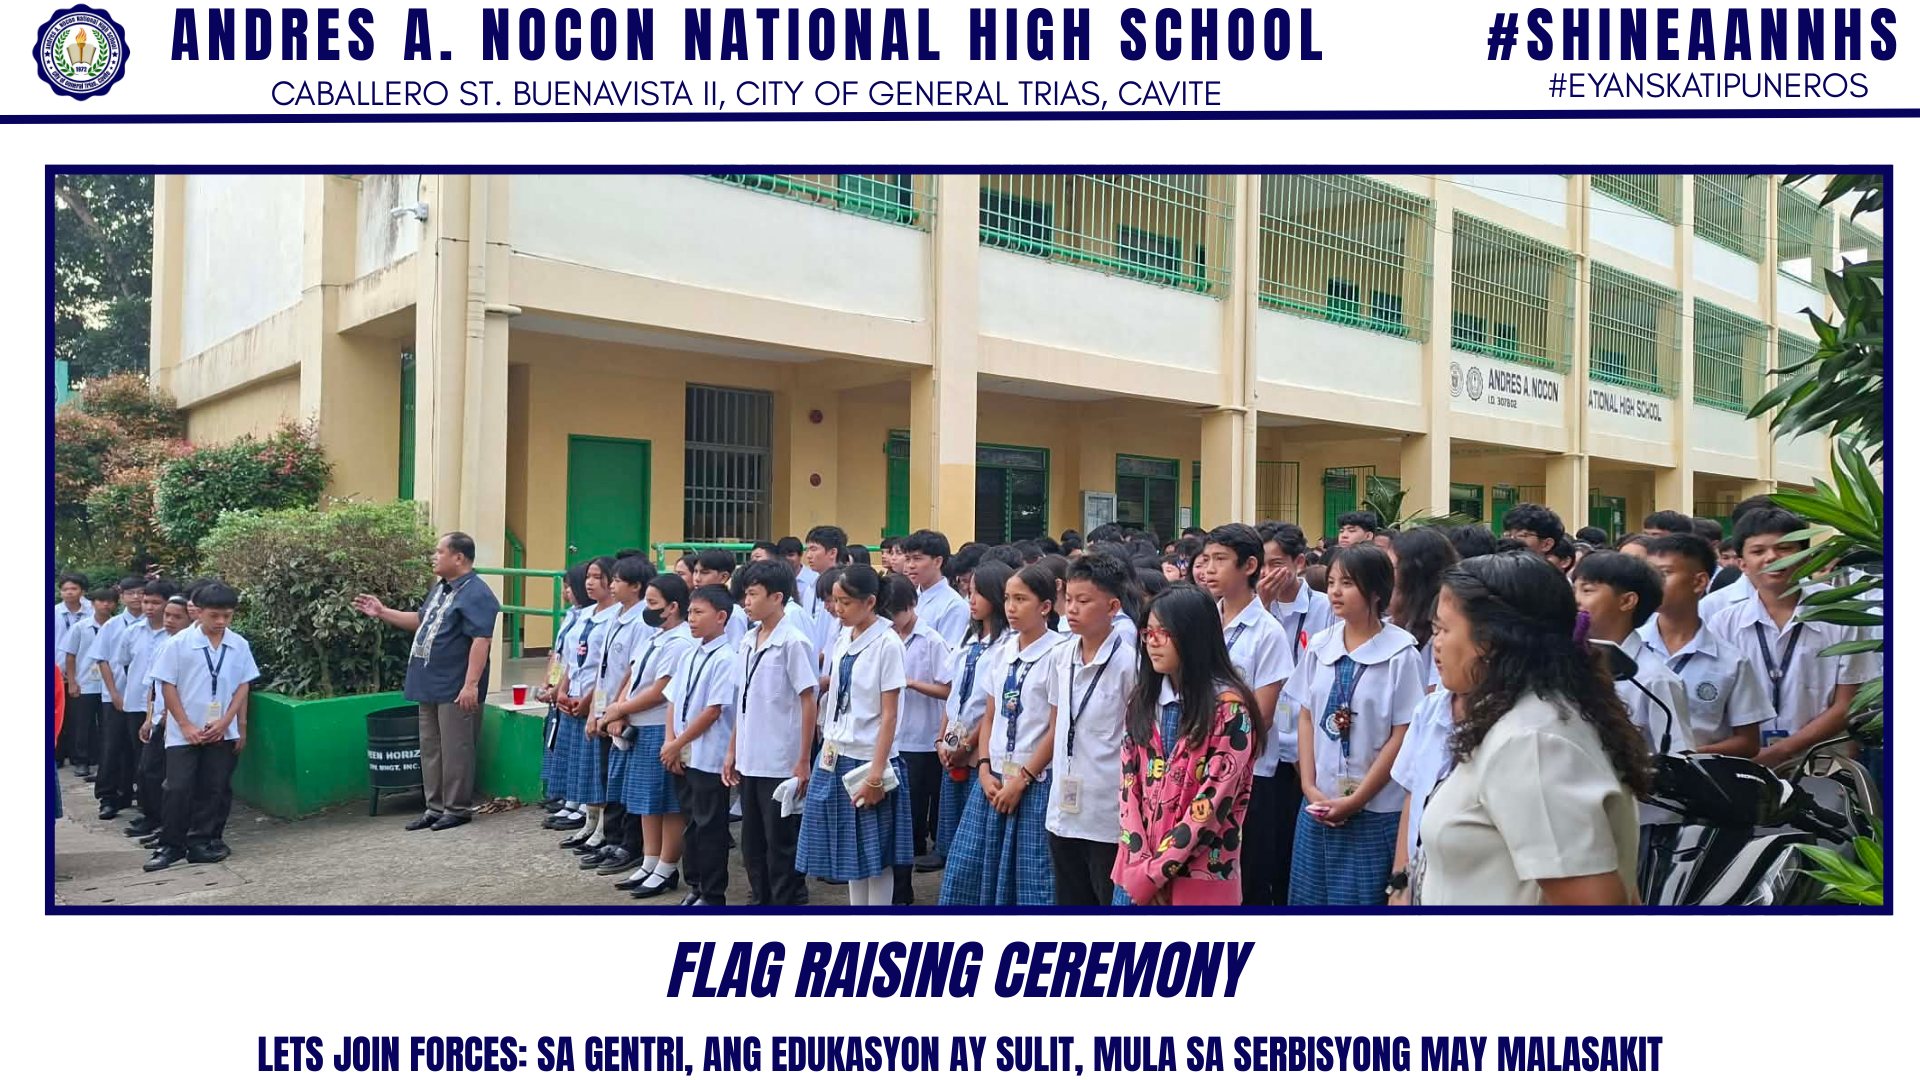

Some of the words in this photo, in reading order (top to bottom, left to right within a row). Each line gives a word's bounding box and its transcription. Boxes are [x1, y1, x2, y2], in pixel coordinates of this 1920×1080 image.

[1488, 368, 1521, 395] ANDRES
[1523, 376, 1530, 397] A.
[1532, 377, 1559, 402] NOCON
[1588, 389, 1618, 413] ATIONAL
[1620, 395, 1635, 416] HIGH
[1637, 399, 1662, 422] SCHOOL
[386, 749, 421, 760] HORIZ
